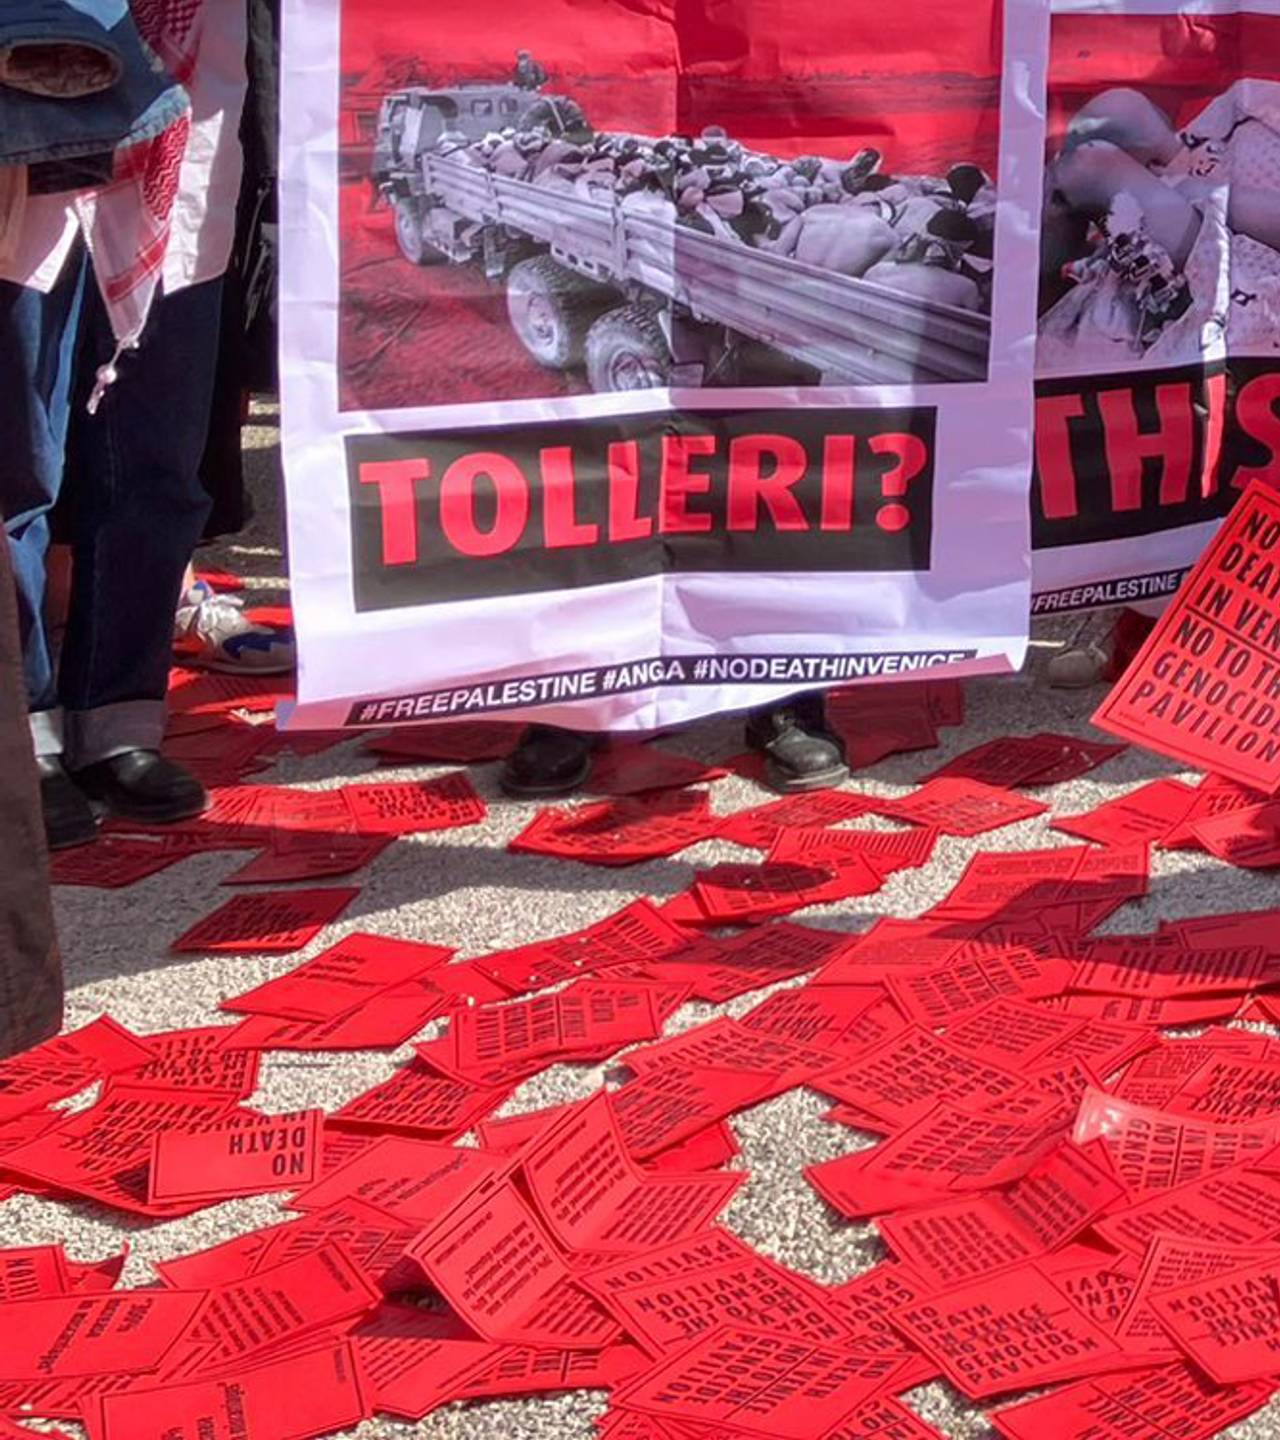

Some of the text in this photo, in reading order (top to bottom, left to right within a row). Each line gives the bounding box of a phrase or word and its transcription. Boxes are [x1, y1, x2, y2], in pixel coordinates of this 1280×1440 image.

[358, 430, 928, 566] TOLLERI?
[1031, 571, 1179, 611] FREEPALESTINE
[1194, 576, 1235, 618] IN
[1170, 615, 1217, 659] NO
[1213, 637, 1251, 679] TO
[360, 671, 599, 722] #FREEPALESTINE
[602, 659, 687, 690] #ANGA
[228, 1127, 307, 1156] DEATH
[271, 1151, 306, 1176] NO
[604, 1239, 733, 1290] PAVILION
[634, 1266, 772, 1313] PAVILION
[1168, 1273, 1279, 1313] AVILION
[902, 1305, 938, 1324] NO
[915, 1303, 993, 1335] DEATH
[961, 1302, 1049, 1339] VENICE
[651, 1332, 757, 1404] PAVILION
[773, 1342, 811, 1364] NO
[954, 1327, 1076, 1372] GENOCIDE
[967, 1336, 1099, 1385] PAVILION
[684, 1337, 782, 1406] GENOCIDE
[751, 1363, 787, 1383] TO
